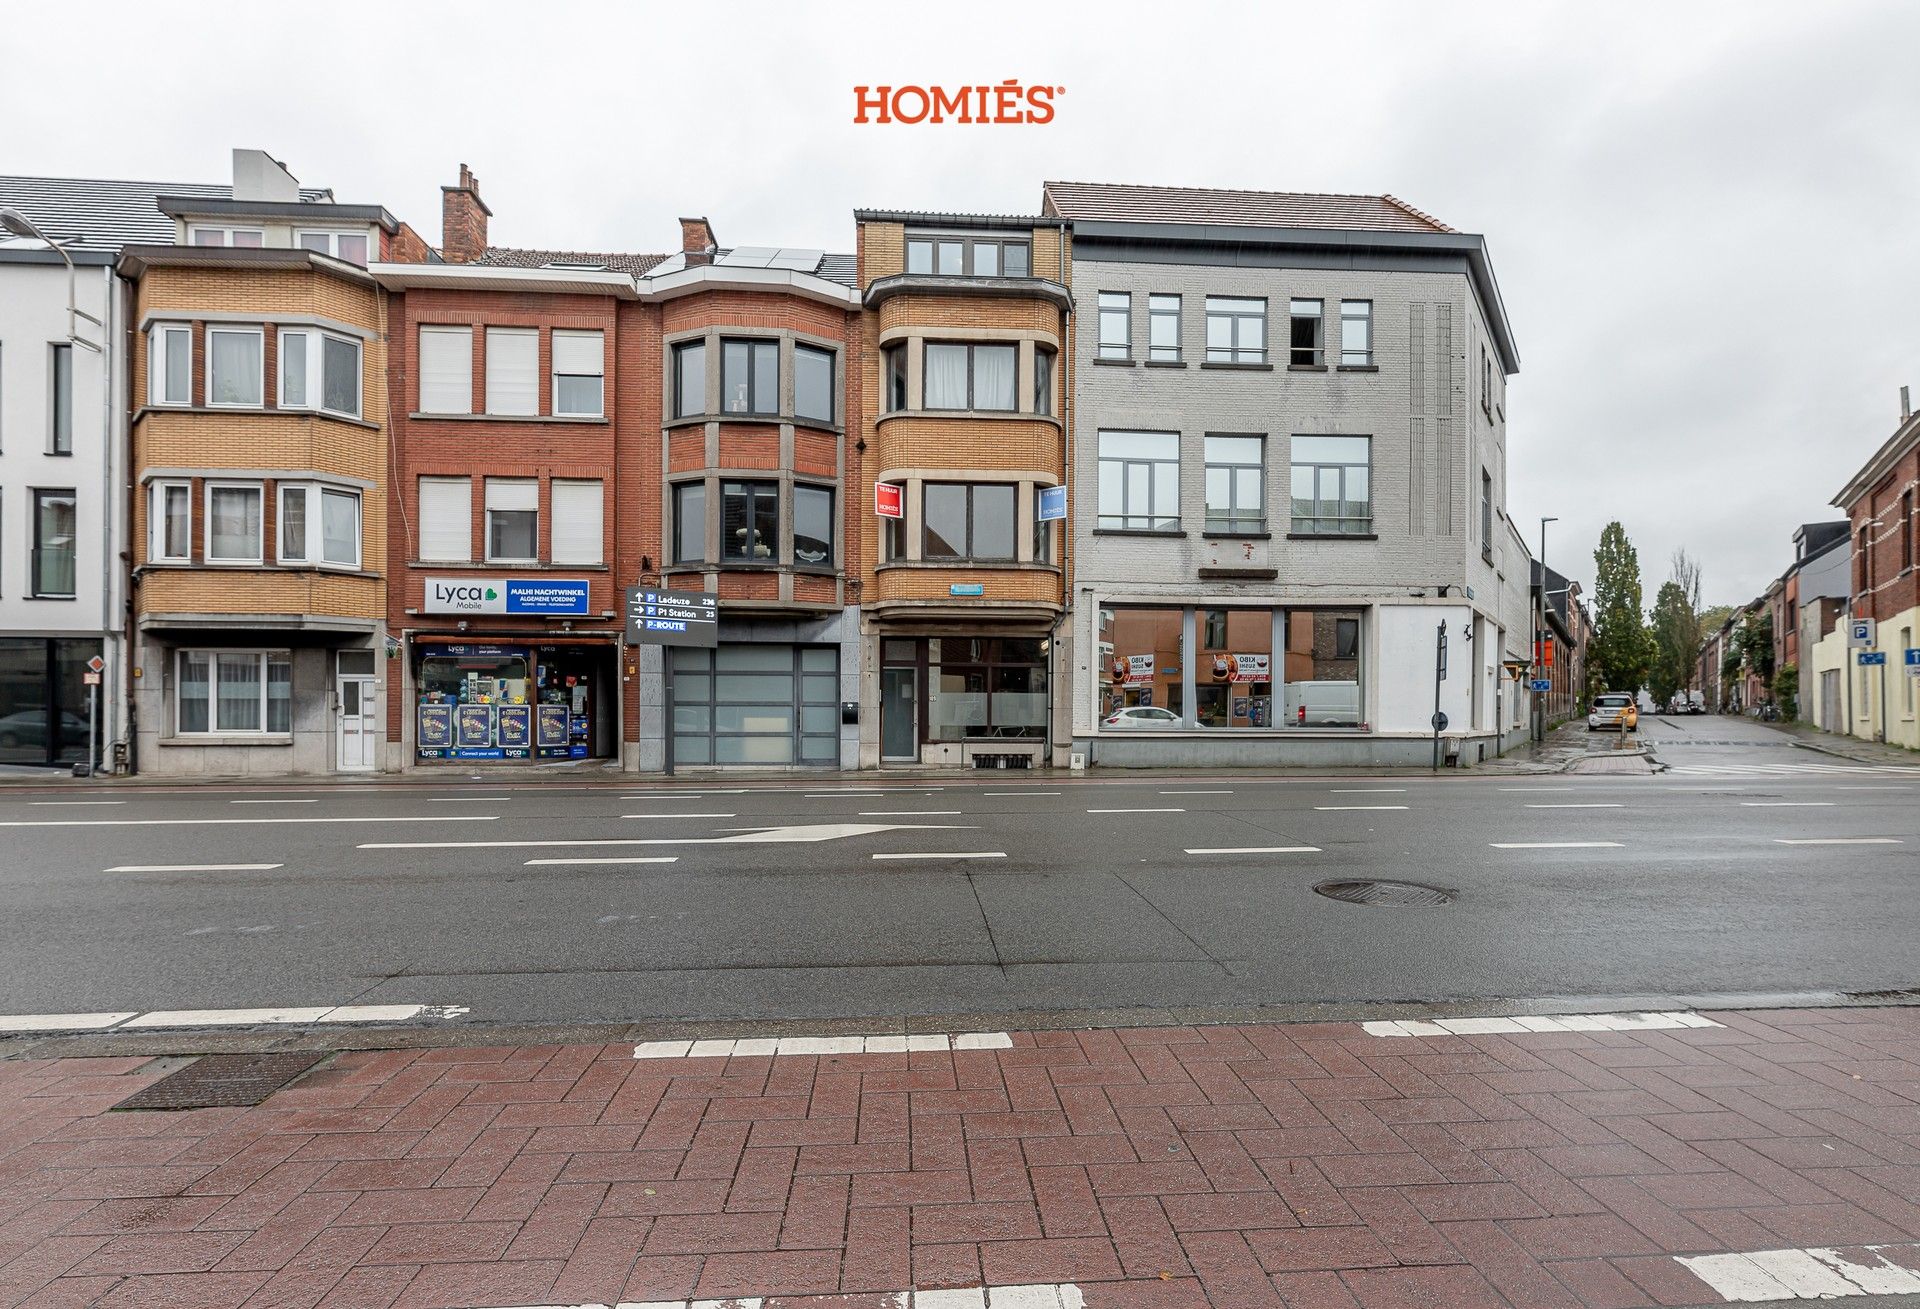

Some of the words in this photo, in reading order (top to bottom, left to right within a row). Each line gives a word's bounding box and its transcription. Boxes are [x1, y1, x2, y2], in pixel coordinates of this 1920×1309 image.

[436, 583, 482, 603] Lyca
[658, 595, 690, 605] Ladeuze
[456, 602, 482, 610] Mobile
[658, 608, 667, 616] P1
[669, 608, 697, 618] Station
[647, 621, 686, 631] P-ROUTE
[1856, 628, 1866, 637] P
